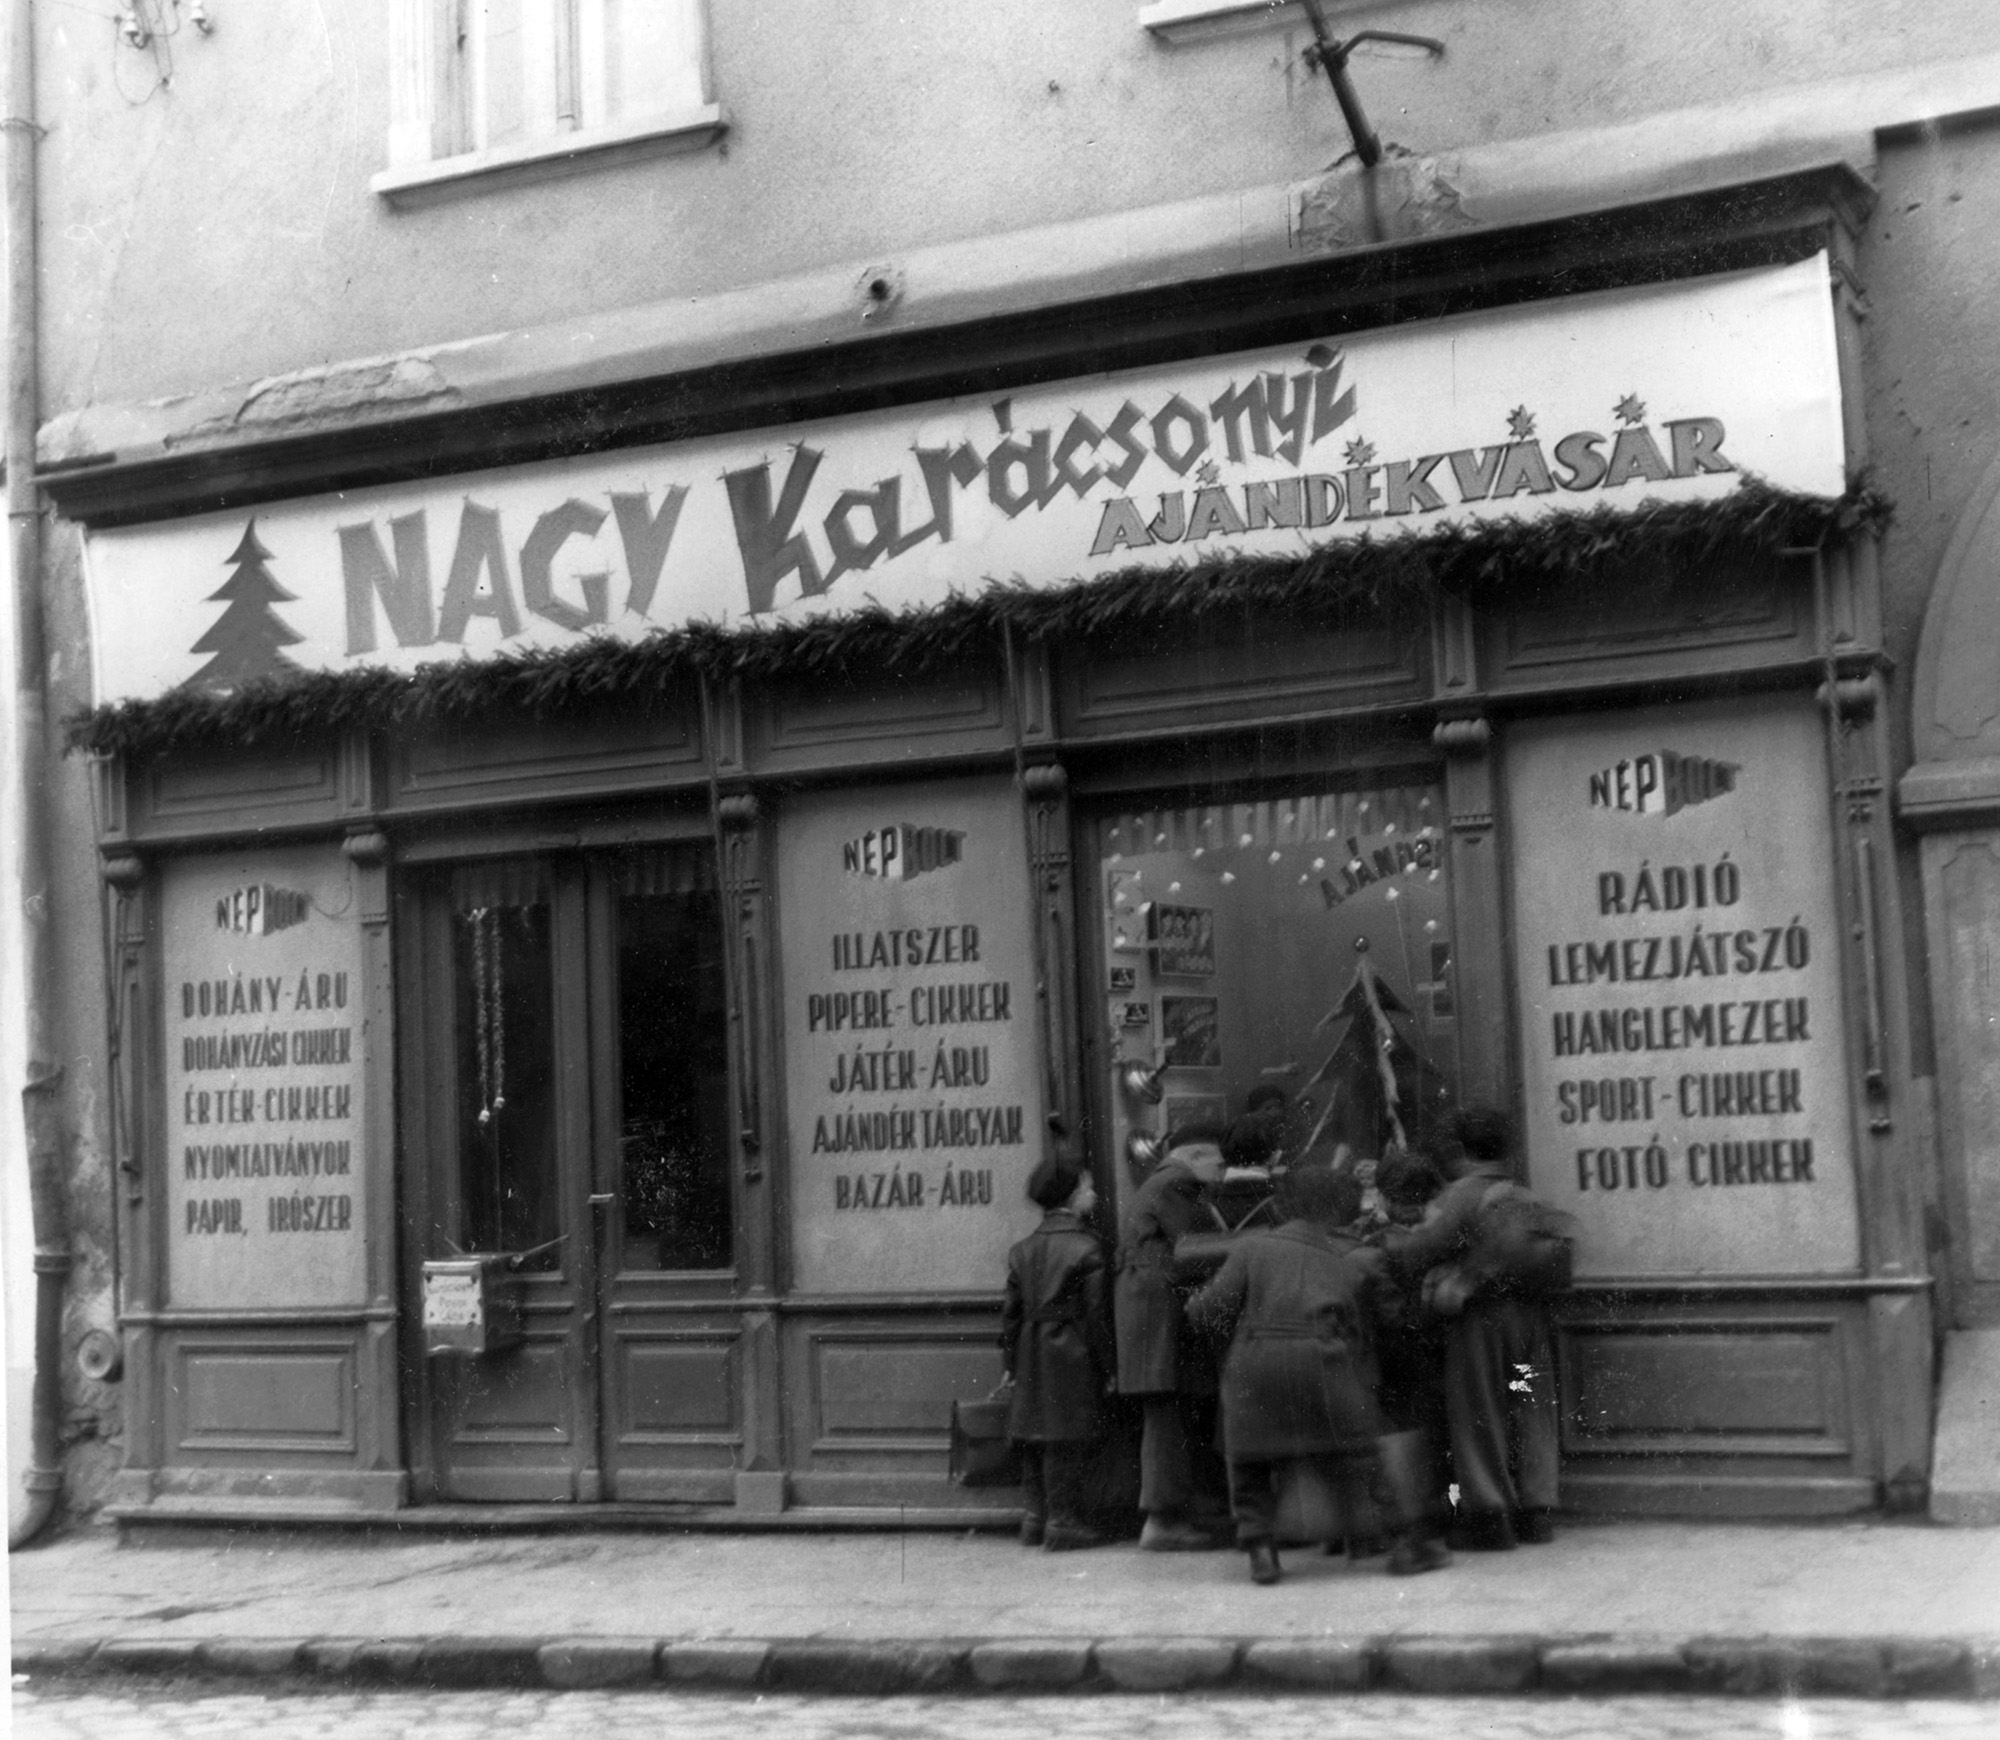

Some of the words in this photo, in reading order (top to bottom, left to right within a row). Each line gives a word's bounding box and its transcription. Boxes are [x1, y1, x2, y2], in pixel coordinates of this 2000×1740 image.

[336, 483, 691, 657] NAGY
[718, 343, 1357, 616] Karácsonyi
[1599, 851, 1740, 915] RÁDIÓ
[833, 924, 981, 971] ILLATSZER
[1548, 915, 1811, 986] LEMEZJÁTSZÓ
[183, 1025, 288, 1072] DOHÁNYZÁSI
[292, 1027, 351, 1065] CIKKEK
[1553, 996, 1812, 1056] HANGLEMEZEK
[812, 1104, 918, 1154] AJÁNDÉK
[919, 1100, 1024, 1148] TÁRGYAK
[184, 1136, 351, 1180] NYOMTATVÁNYOK
[1576, 1132, 1669, 1191] FOTÓ
[1687, 1137, 1817, 1186] CIKKEK
[268, 1189, 352, 1232] IRÓSZER
